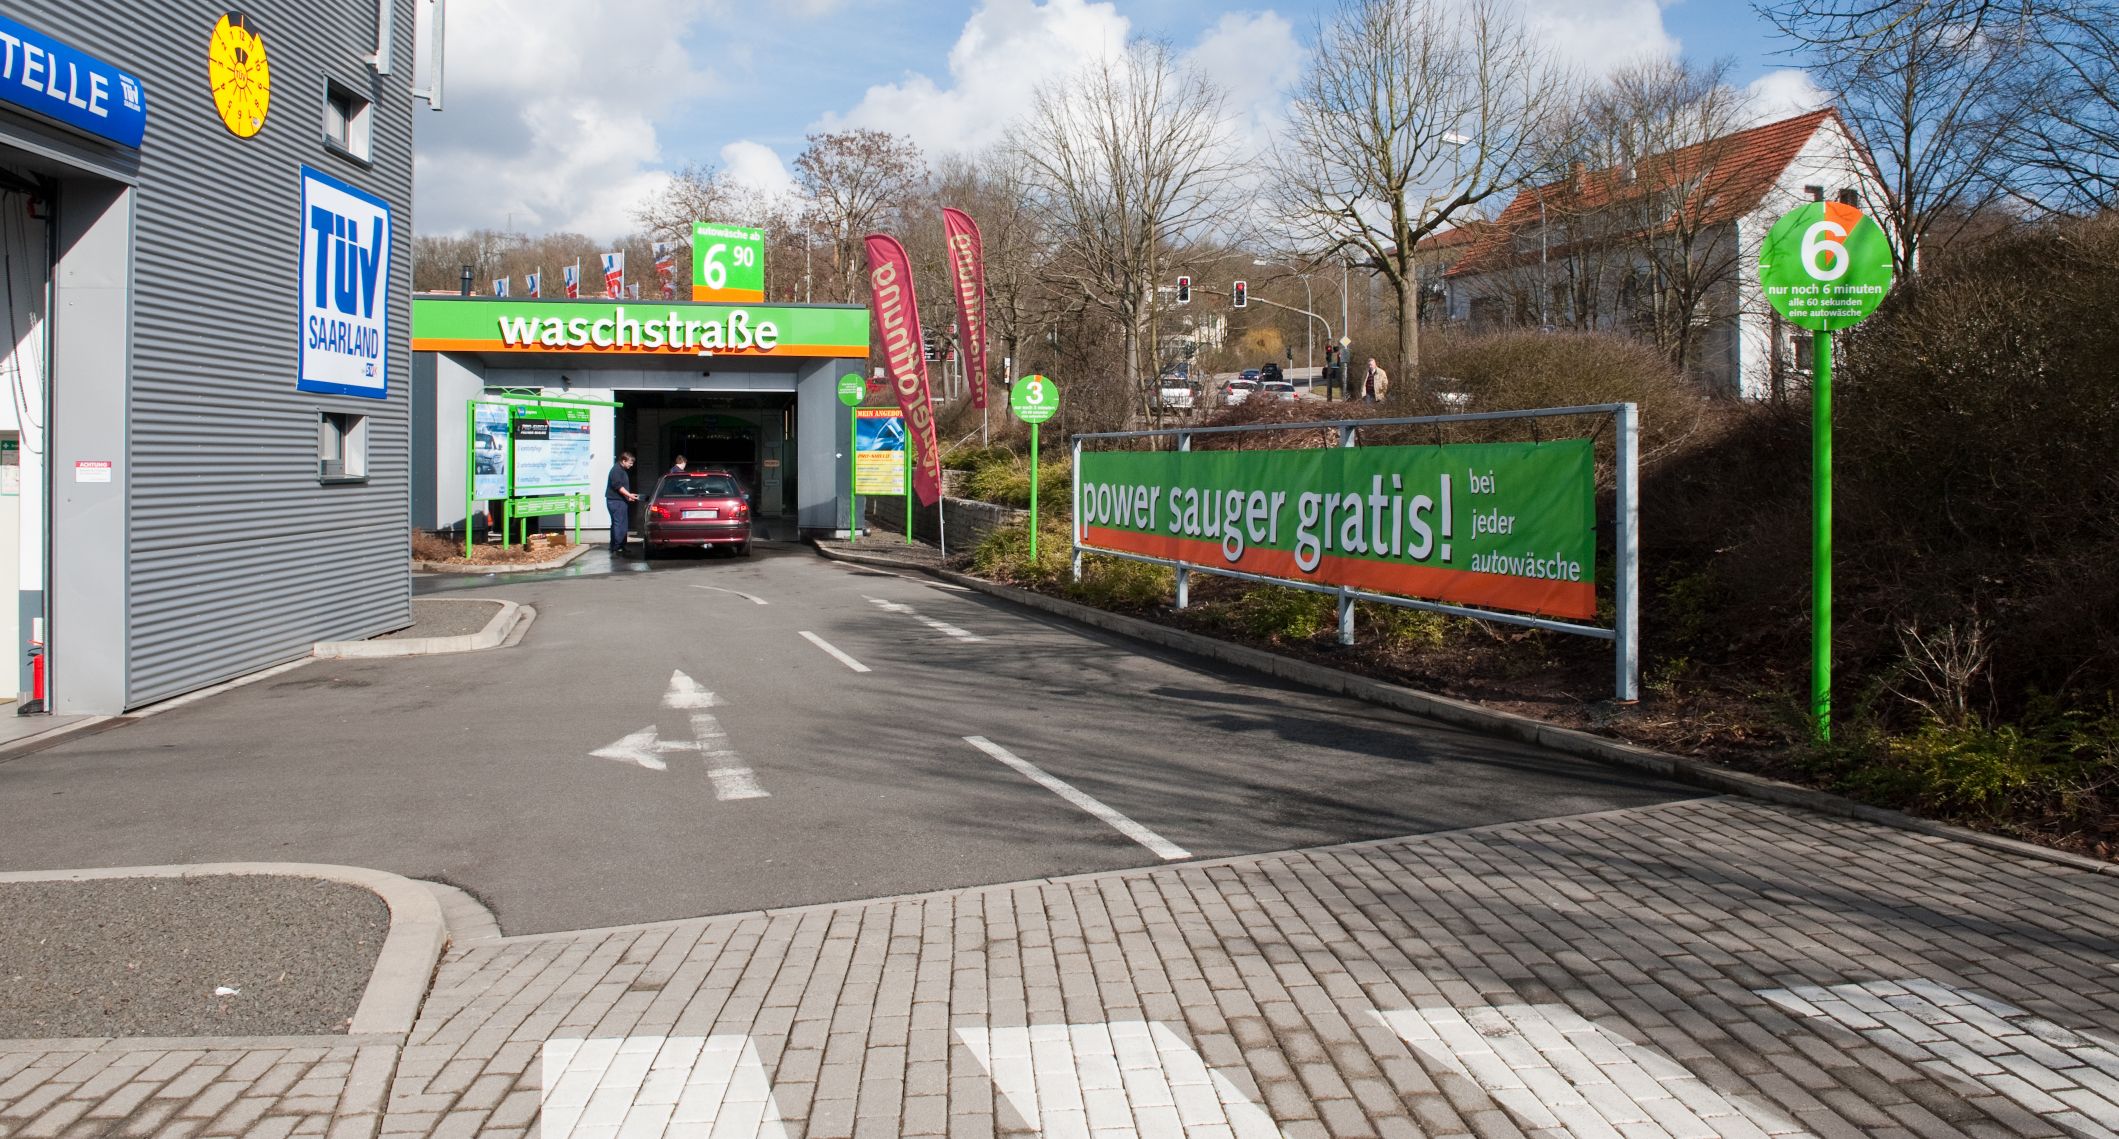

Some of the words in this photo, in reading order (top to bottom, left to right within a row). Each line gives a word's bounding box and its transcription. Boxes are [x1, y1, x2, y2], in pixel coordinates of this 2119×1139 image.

[697, 226, 748, 239] autowäsche
[750, 231, 760, 240] ab
[311, 205, 383, 319] TÜV
[704, 243, 727, 290] 6
[733, 246, 754, 267] 90
[1801, 221, 1849, 281] 6
[1769, 285, 1788, 294] nur
[1791, 284, 1819, 294] noch
[1823, 284, 1831, 294] 6
[1834, 284, 1882, 294] minuten
[1788, 298, 1804, 306] alle
[1806, 298, 1818, 306] 60
[1821, 298, 1862, 306] sekunden
[499, 307, 778, 349] waschstraße
[1789, 309, 1807, 317] eine
[1810, 308, 1862, 317] autowäsche
[309, 315, 379, 359] SAARLAND
[1026, 381, 1043, 405] 3
[1469, 468, 1495, 494] bei
[1084, 482, 1160, 539] power
[1169, 486, 1285, 562] sauger
[1295, 474, 1451, 572] gratis!
[1472, 508, 1515, 540] jeder
[1472, 550, 1580, 581] autowäsche
